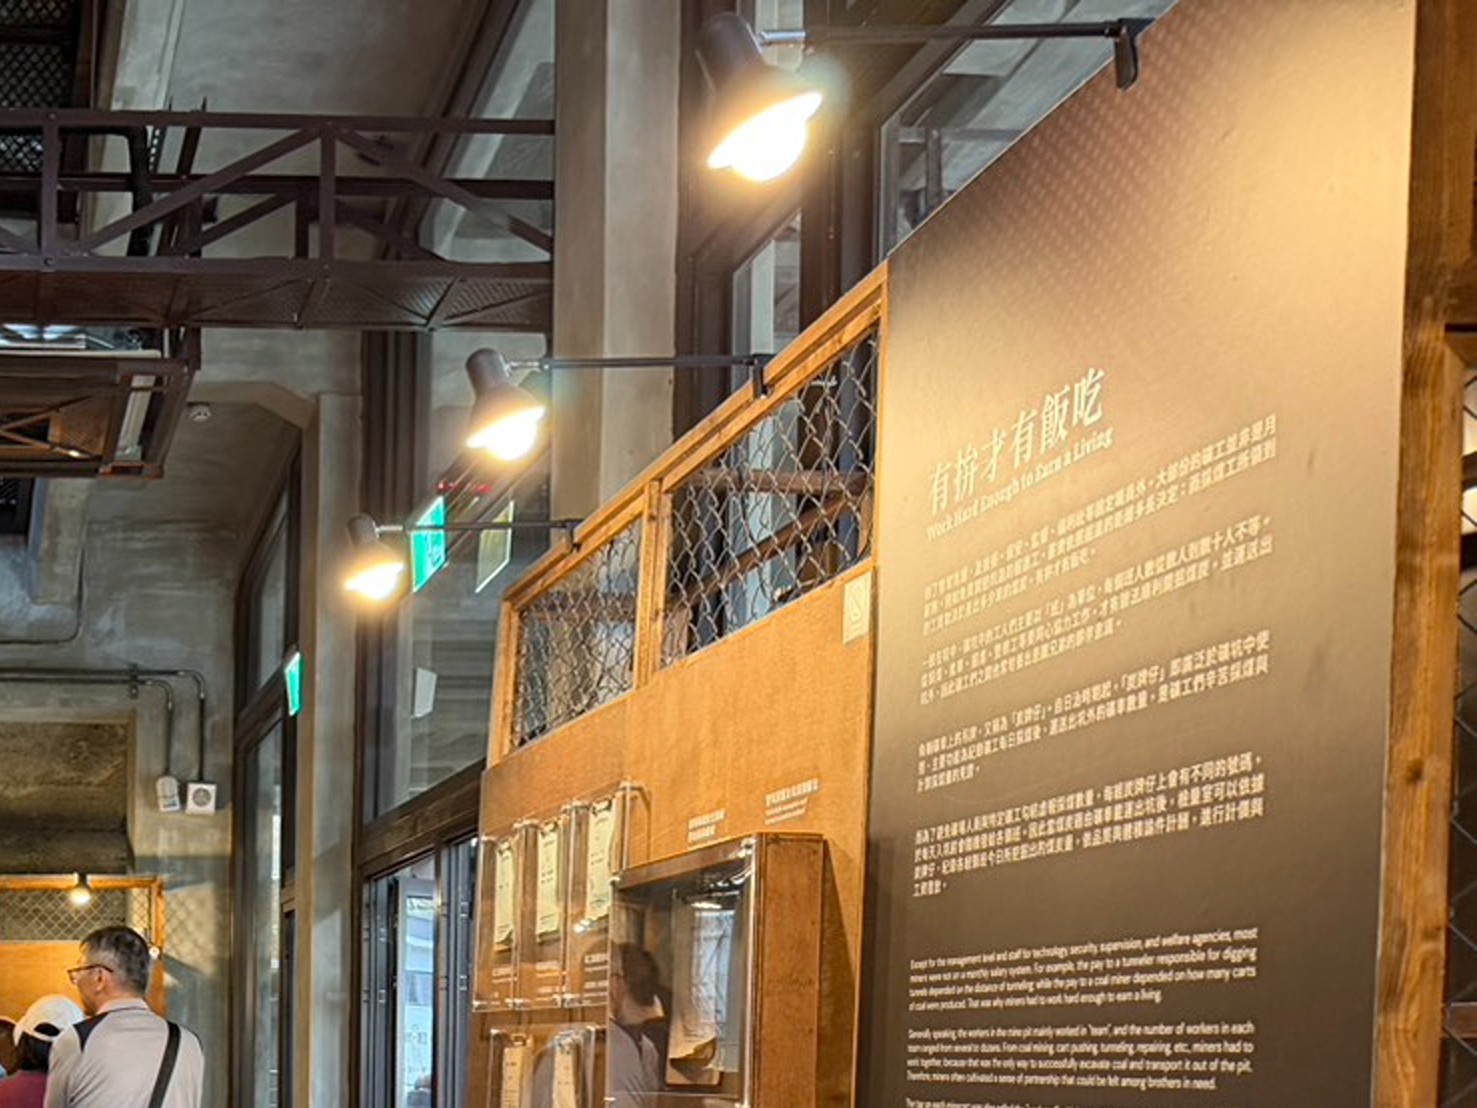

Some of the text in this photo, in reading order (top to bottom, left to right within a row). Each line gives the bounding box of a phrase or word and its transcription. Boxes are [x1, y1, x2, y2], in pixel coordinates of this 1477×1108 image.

[1021, 472, 1034, 491] to
[1074, 426, 1114, 461] Living
[1232, 926, 1258, 940] most
[1221, 945, 1257, 962] digging
[1231, 965, 1256, 977] carts
[1230, 1020, 1254, 1033] each
[1222, 1039, 1241, 1052] had
